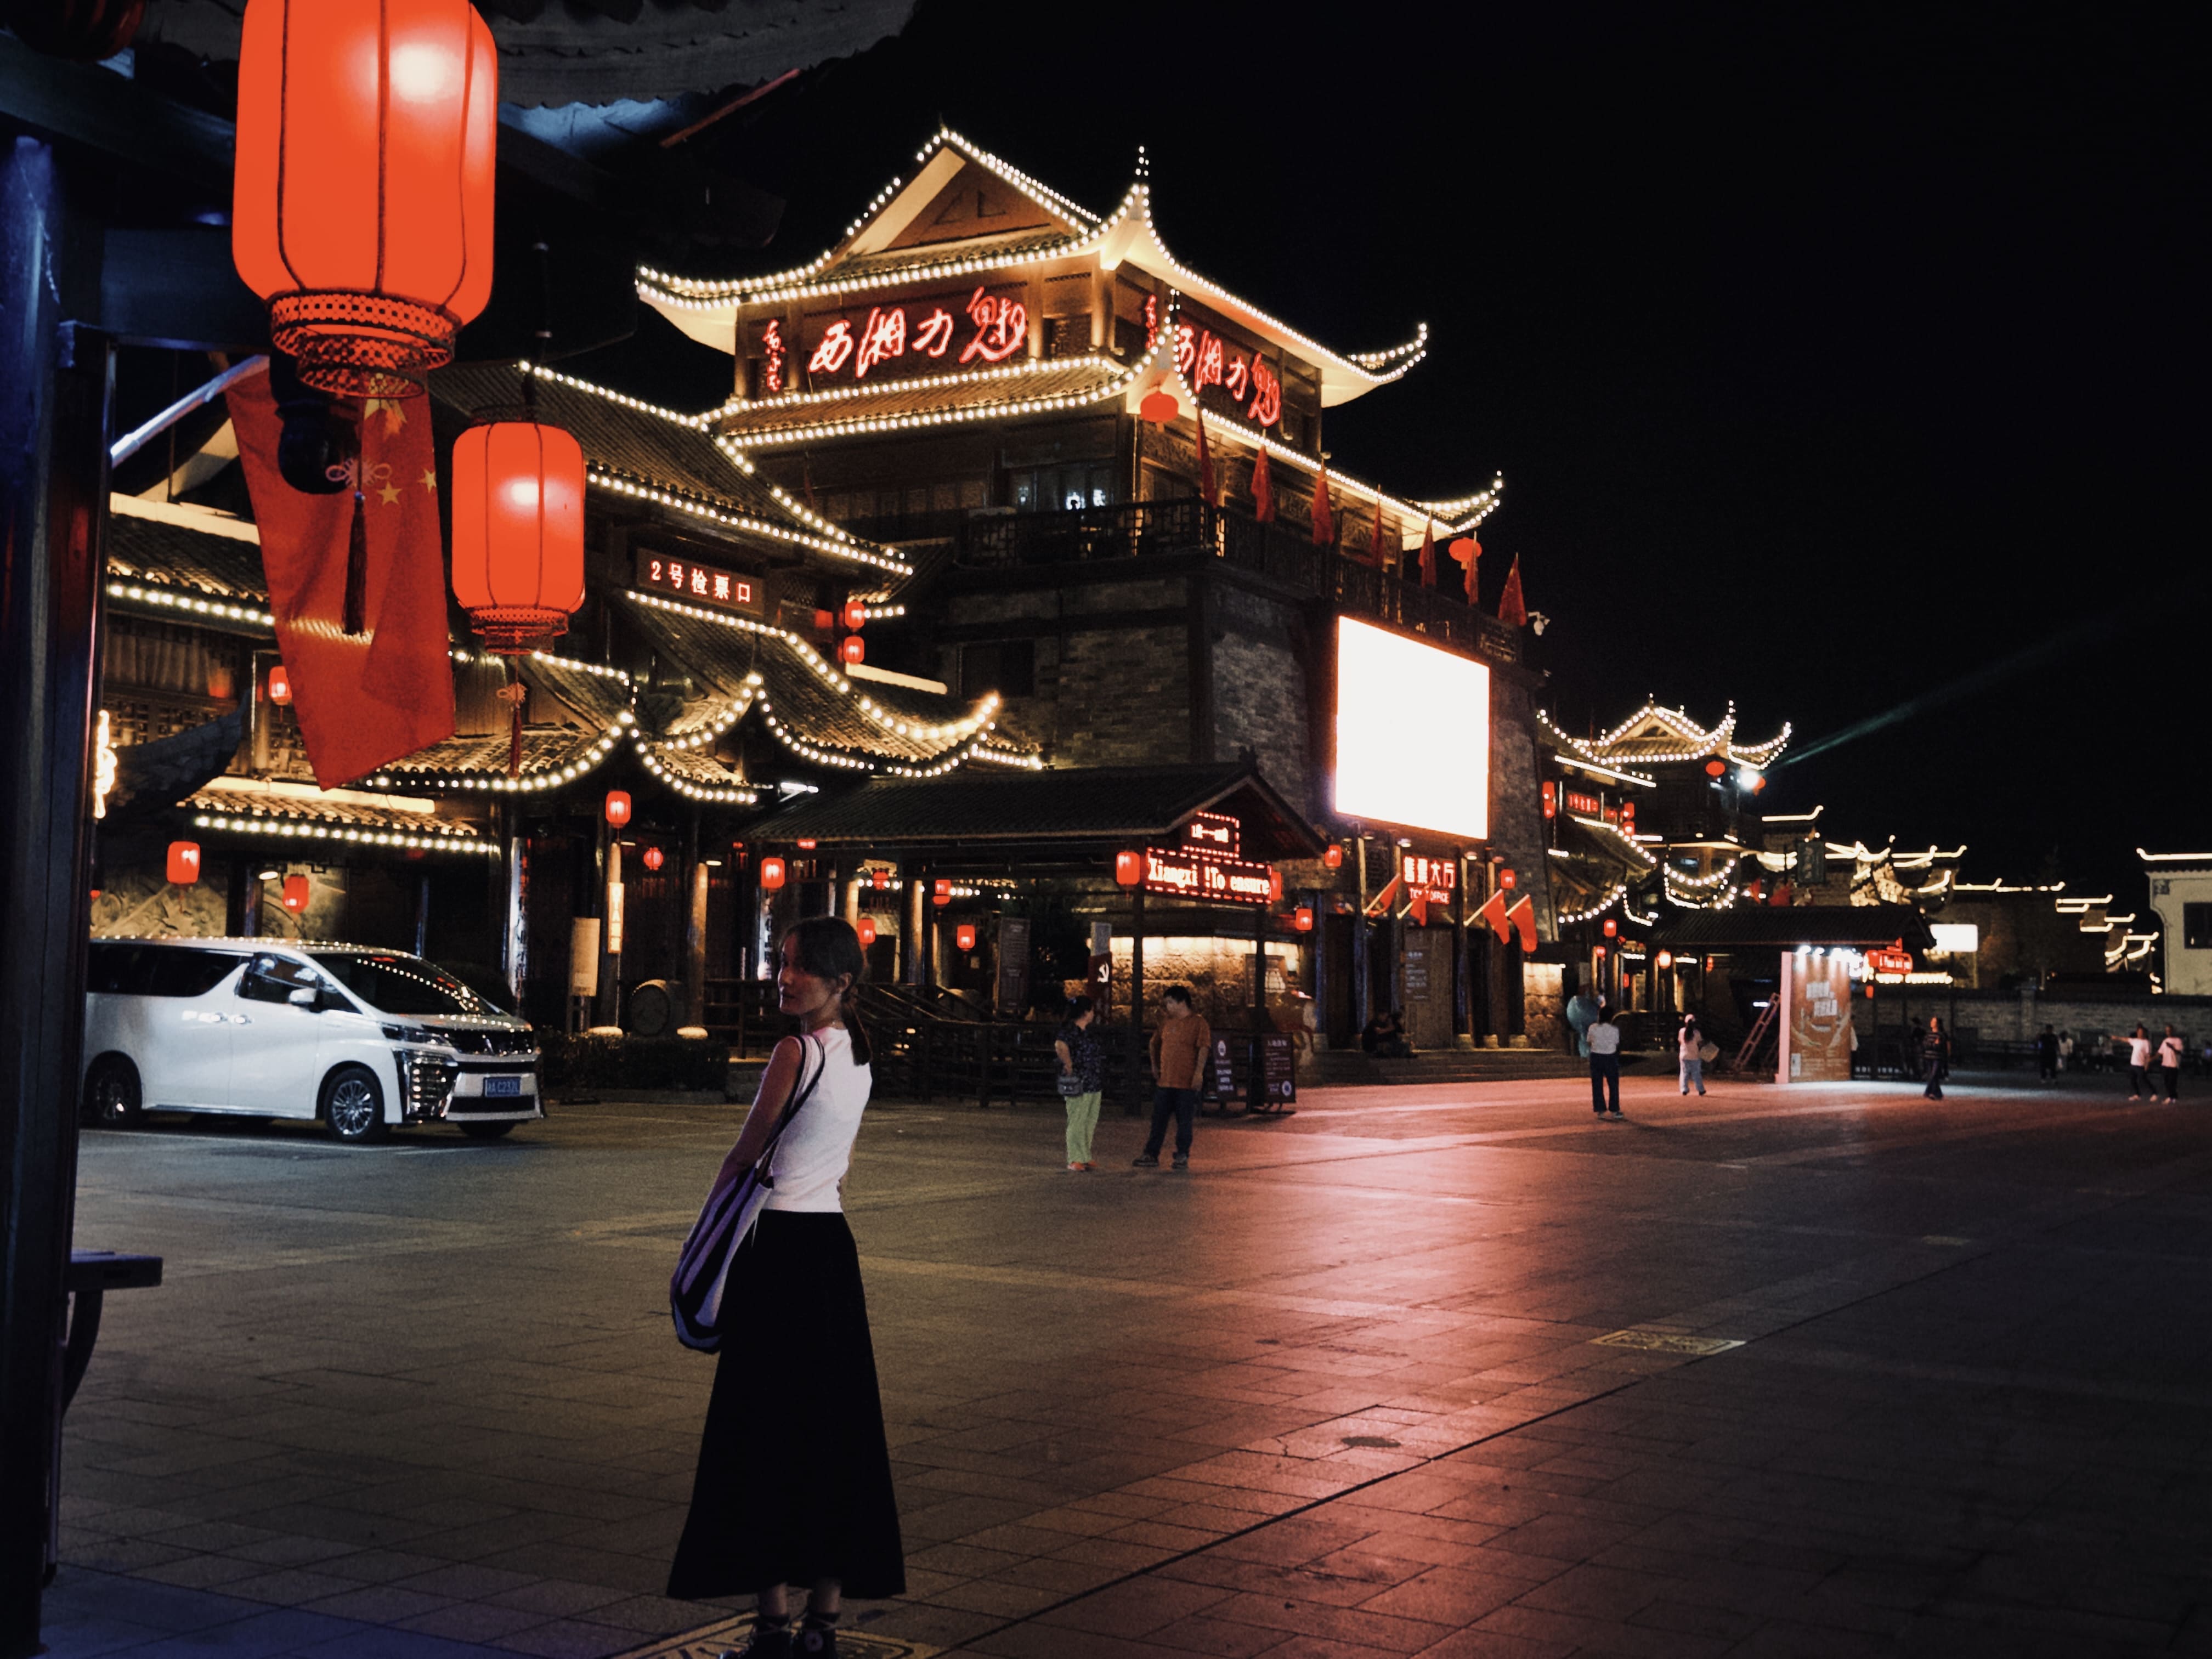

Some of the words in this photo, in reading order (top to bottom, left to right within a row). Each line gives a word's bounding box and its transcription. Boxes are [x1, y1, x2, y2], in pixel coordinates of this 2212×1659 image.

[650, 560, 751, 603] 2号检票口
[1149, 858, 1198, 888] Xiangxi
[1230, 876, 1270, 895] ensure
